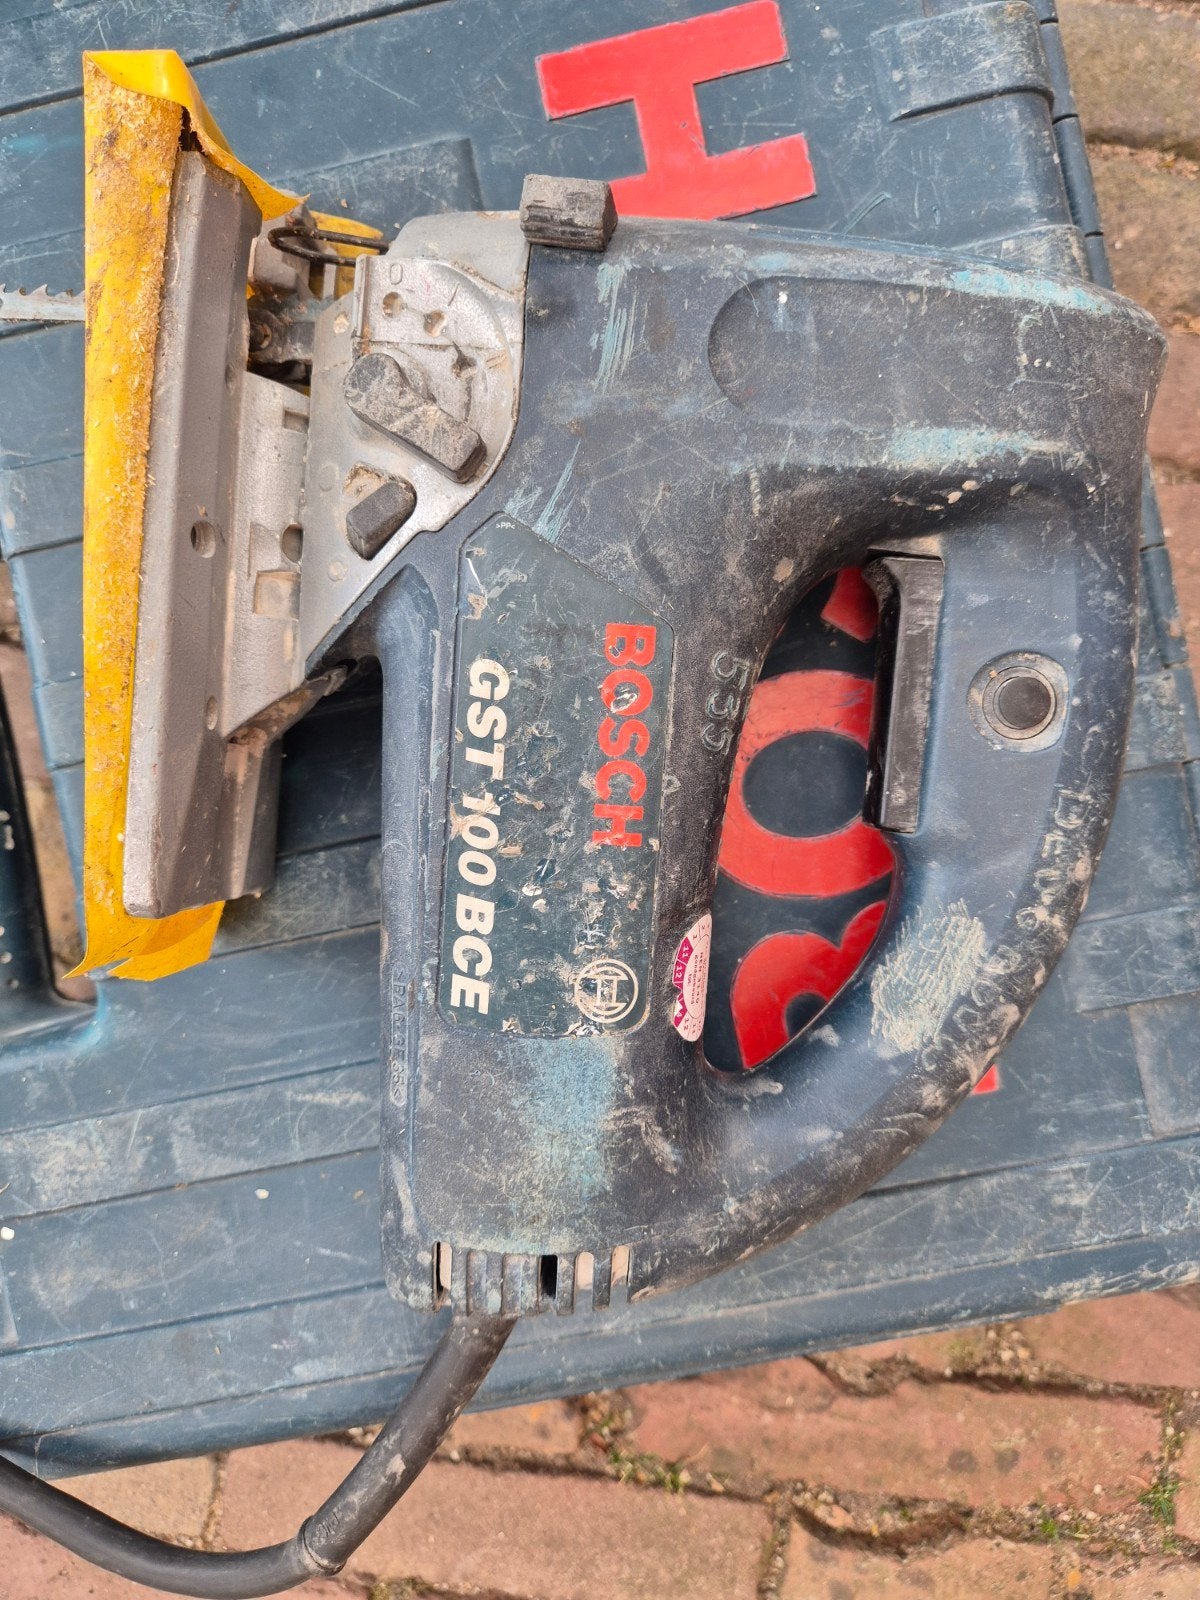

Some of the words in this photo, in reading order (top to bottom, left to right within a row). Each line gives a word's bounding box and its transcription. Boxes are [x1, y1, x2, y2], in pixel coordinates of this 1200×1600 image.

[465, 658, 511, 780] GST
[592, 622, 657, 848] BOSCH
[701, 651, 751, 756] 535
[458, 791, 501, 887] 100
[450, 893, 496, 1015] BCE
[674, 965, 683, 979] 12
[682, 945, 690, 957] 11
